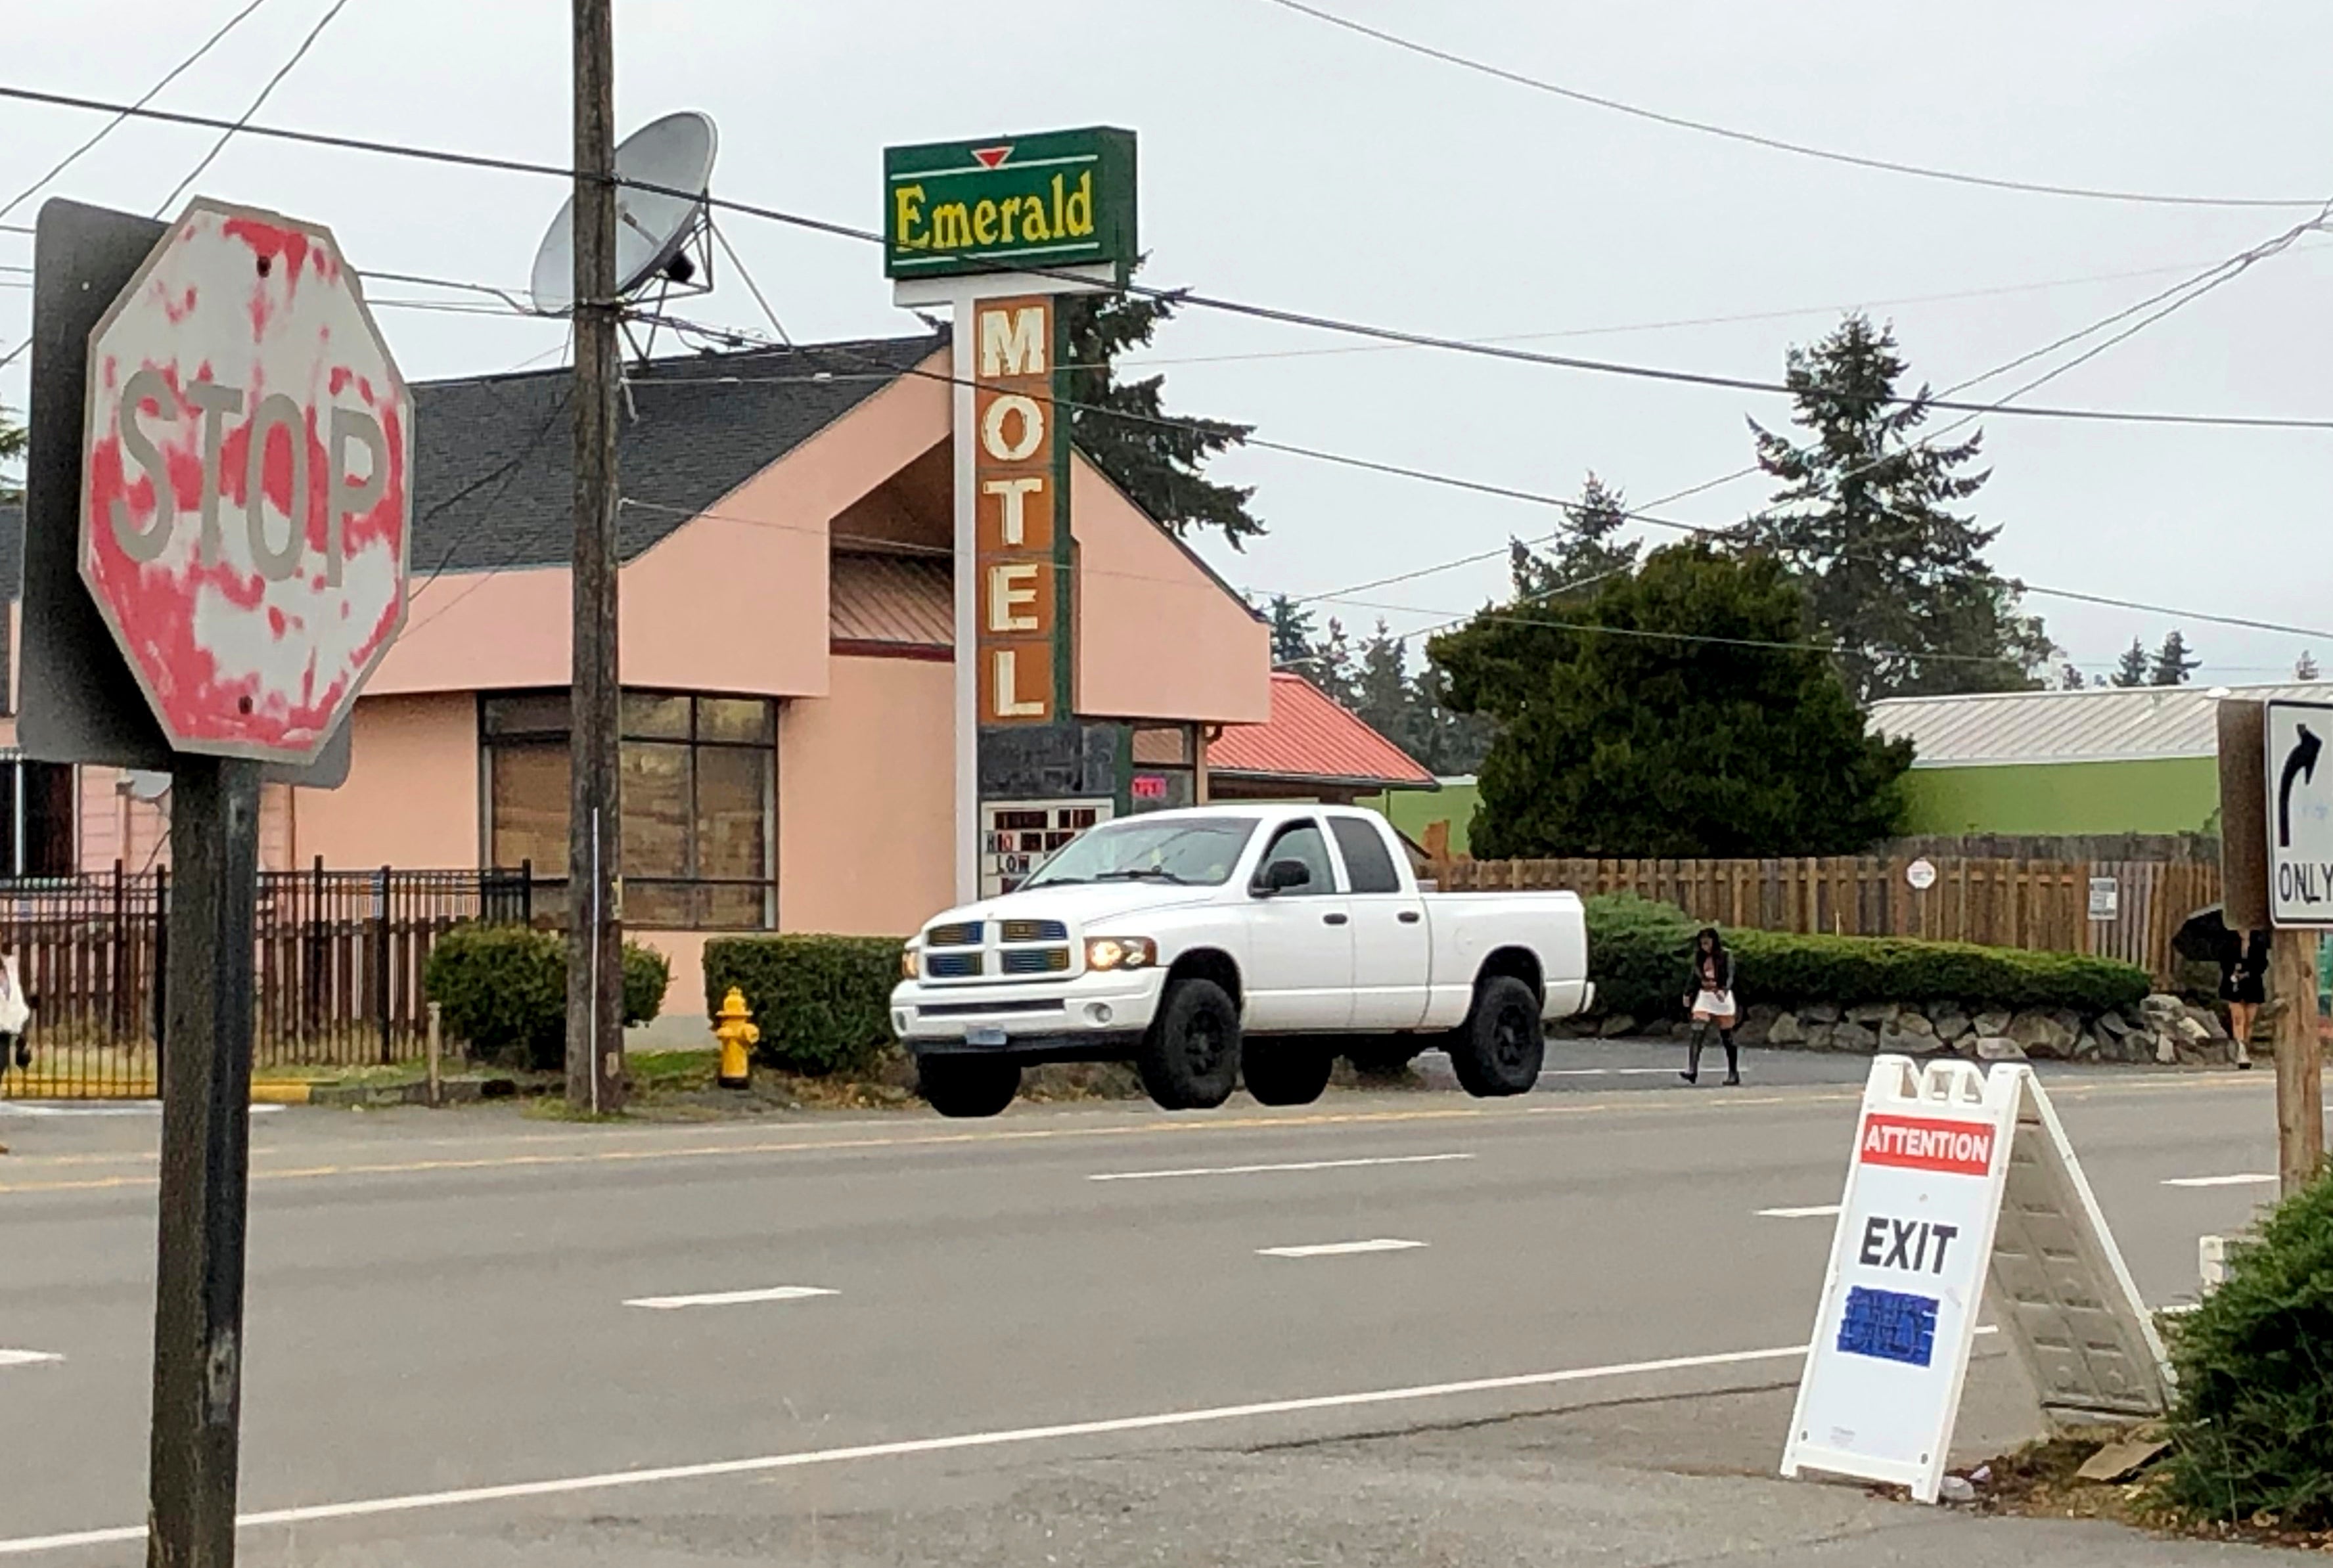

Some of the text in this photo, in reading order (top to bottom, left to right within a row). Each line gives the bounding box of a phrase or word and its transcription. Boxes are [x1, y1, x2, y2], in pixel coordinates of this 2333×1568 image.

[895, 170, 1095, 252] Emerald
[110, 368, 389, 588] STOP
[979, 306, 1046, 717] MOTEL
[2278, 861, 2333, 904] ONLY
[1865, 1124, 1989, 1164] ATTENTION
[1858, 1216, 1959, 1274] EXIT
